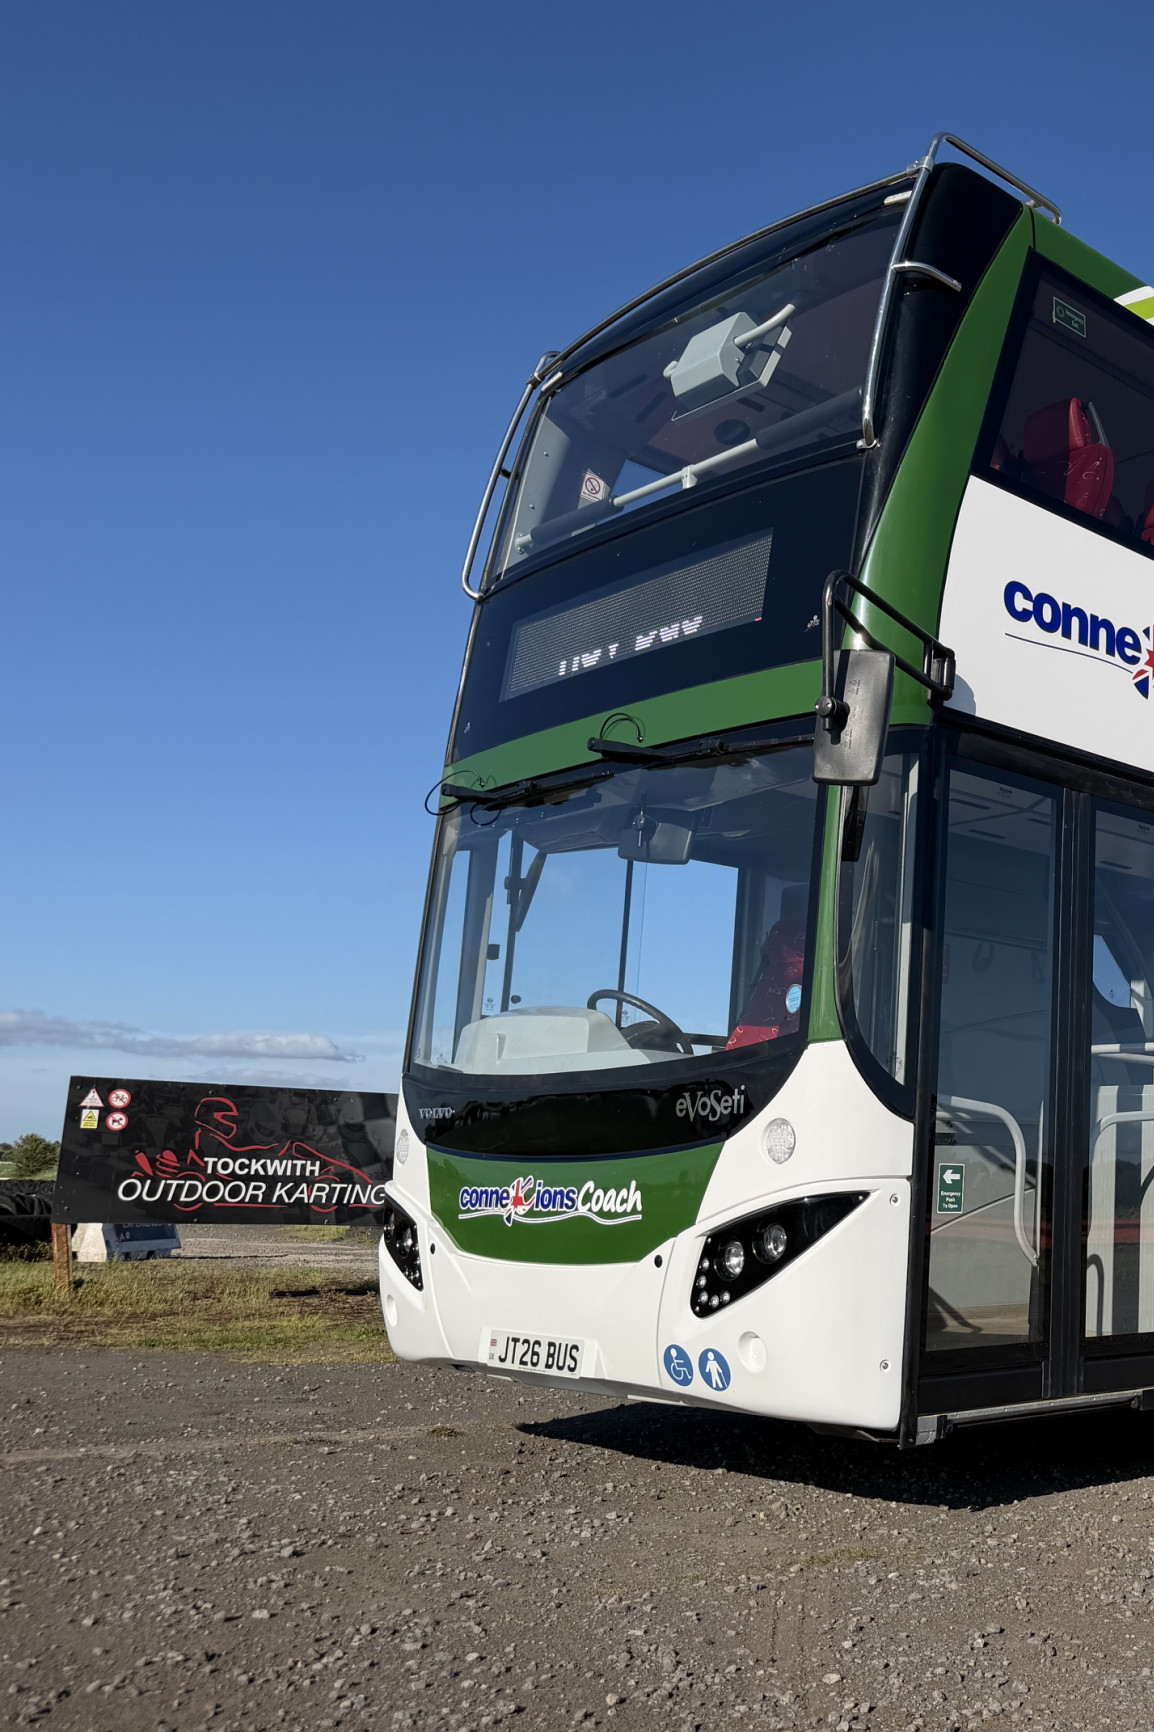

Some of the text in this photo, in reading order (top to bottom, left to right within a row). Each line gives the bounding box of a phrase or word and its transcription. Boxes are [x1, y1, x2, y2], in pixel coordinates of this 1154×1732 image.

[418, 1107, 453, 1119] VOLVO
[204, 1157, 320, 1176] TOCKWITH
[117, 1179, 385, 1204] OUTDOOR KARTING
[498, 1336, 580, 1372] JT26 BUS
